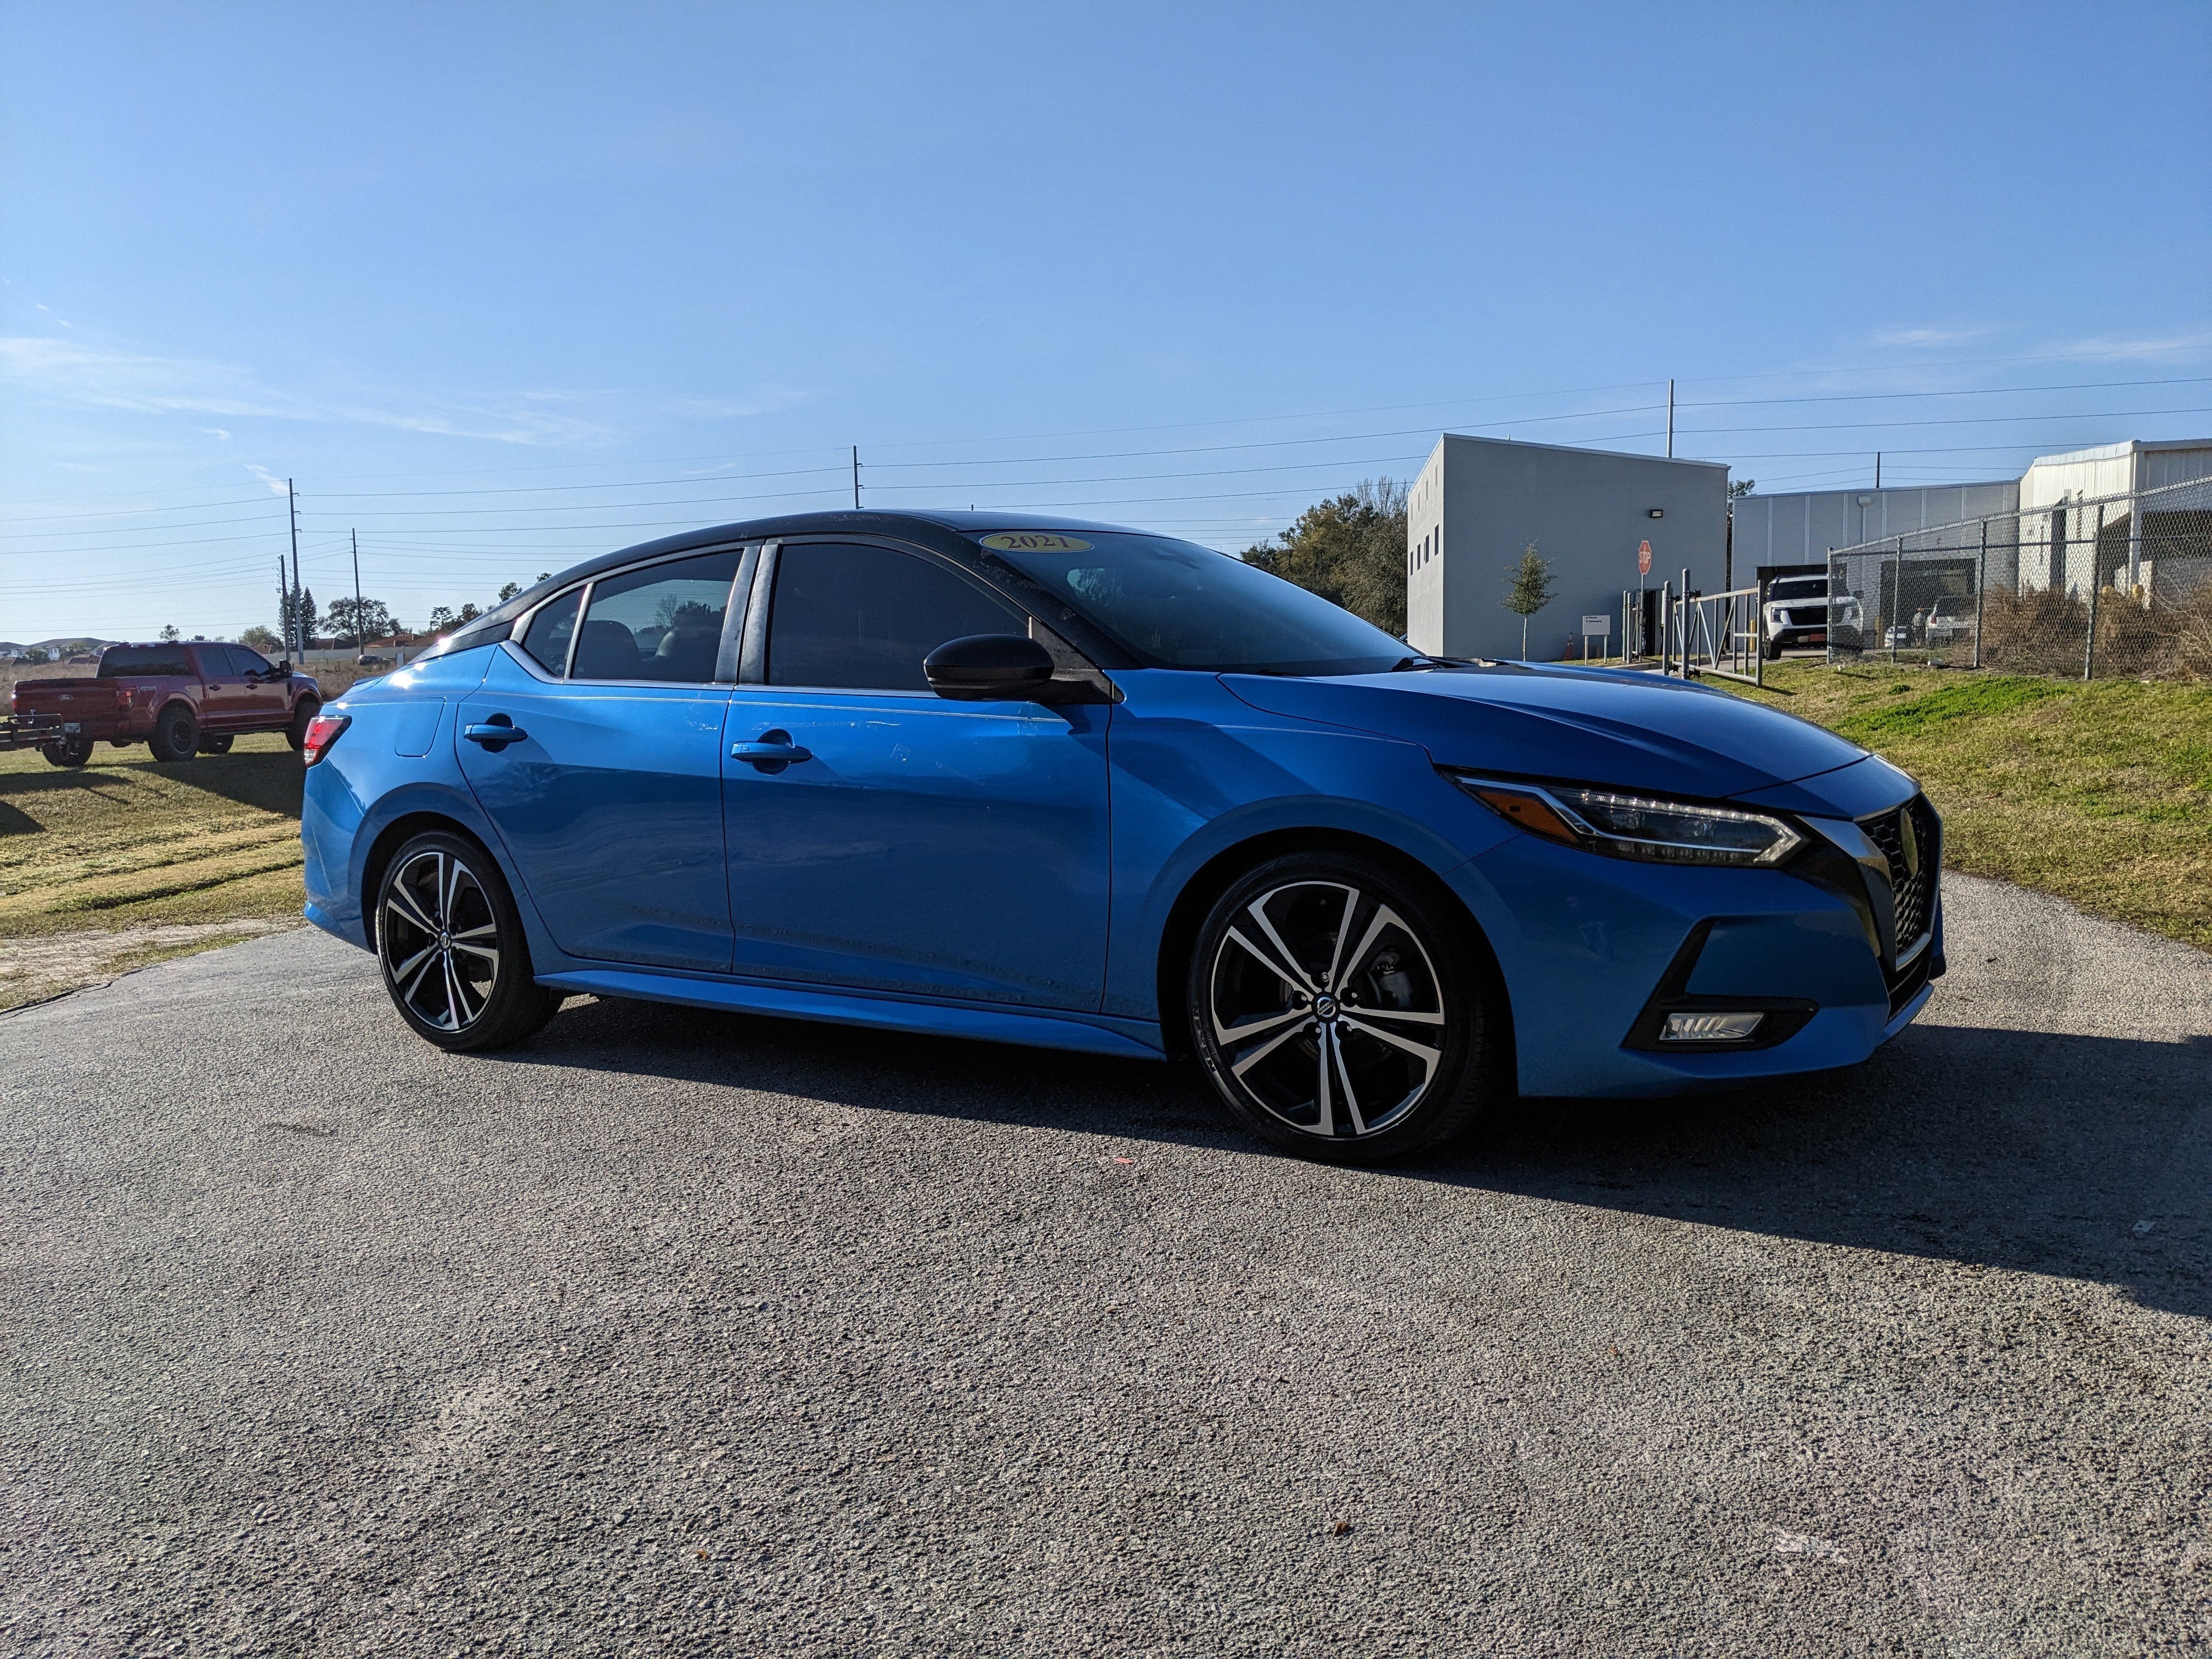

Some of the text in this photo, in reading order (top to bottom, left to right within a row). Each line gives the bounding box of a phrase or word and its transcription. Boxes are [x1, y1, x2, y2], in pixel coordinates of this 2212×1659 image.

[1001, 535, 1073, 549] 2021
[1639, 551, 1650, 564] STOP
[1318, 1000, 1335, 1013] NISSAN
